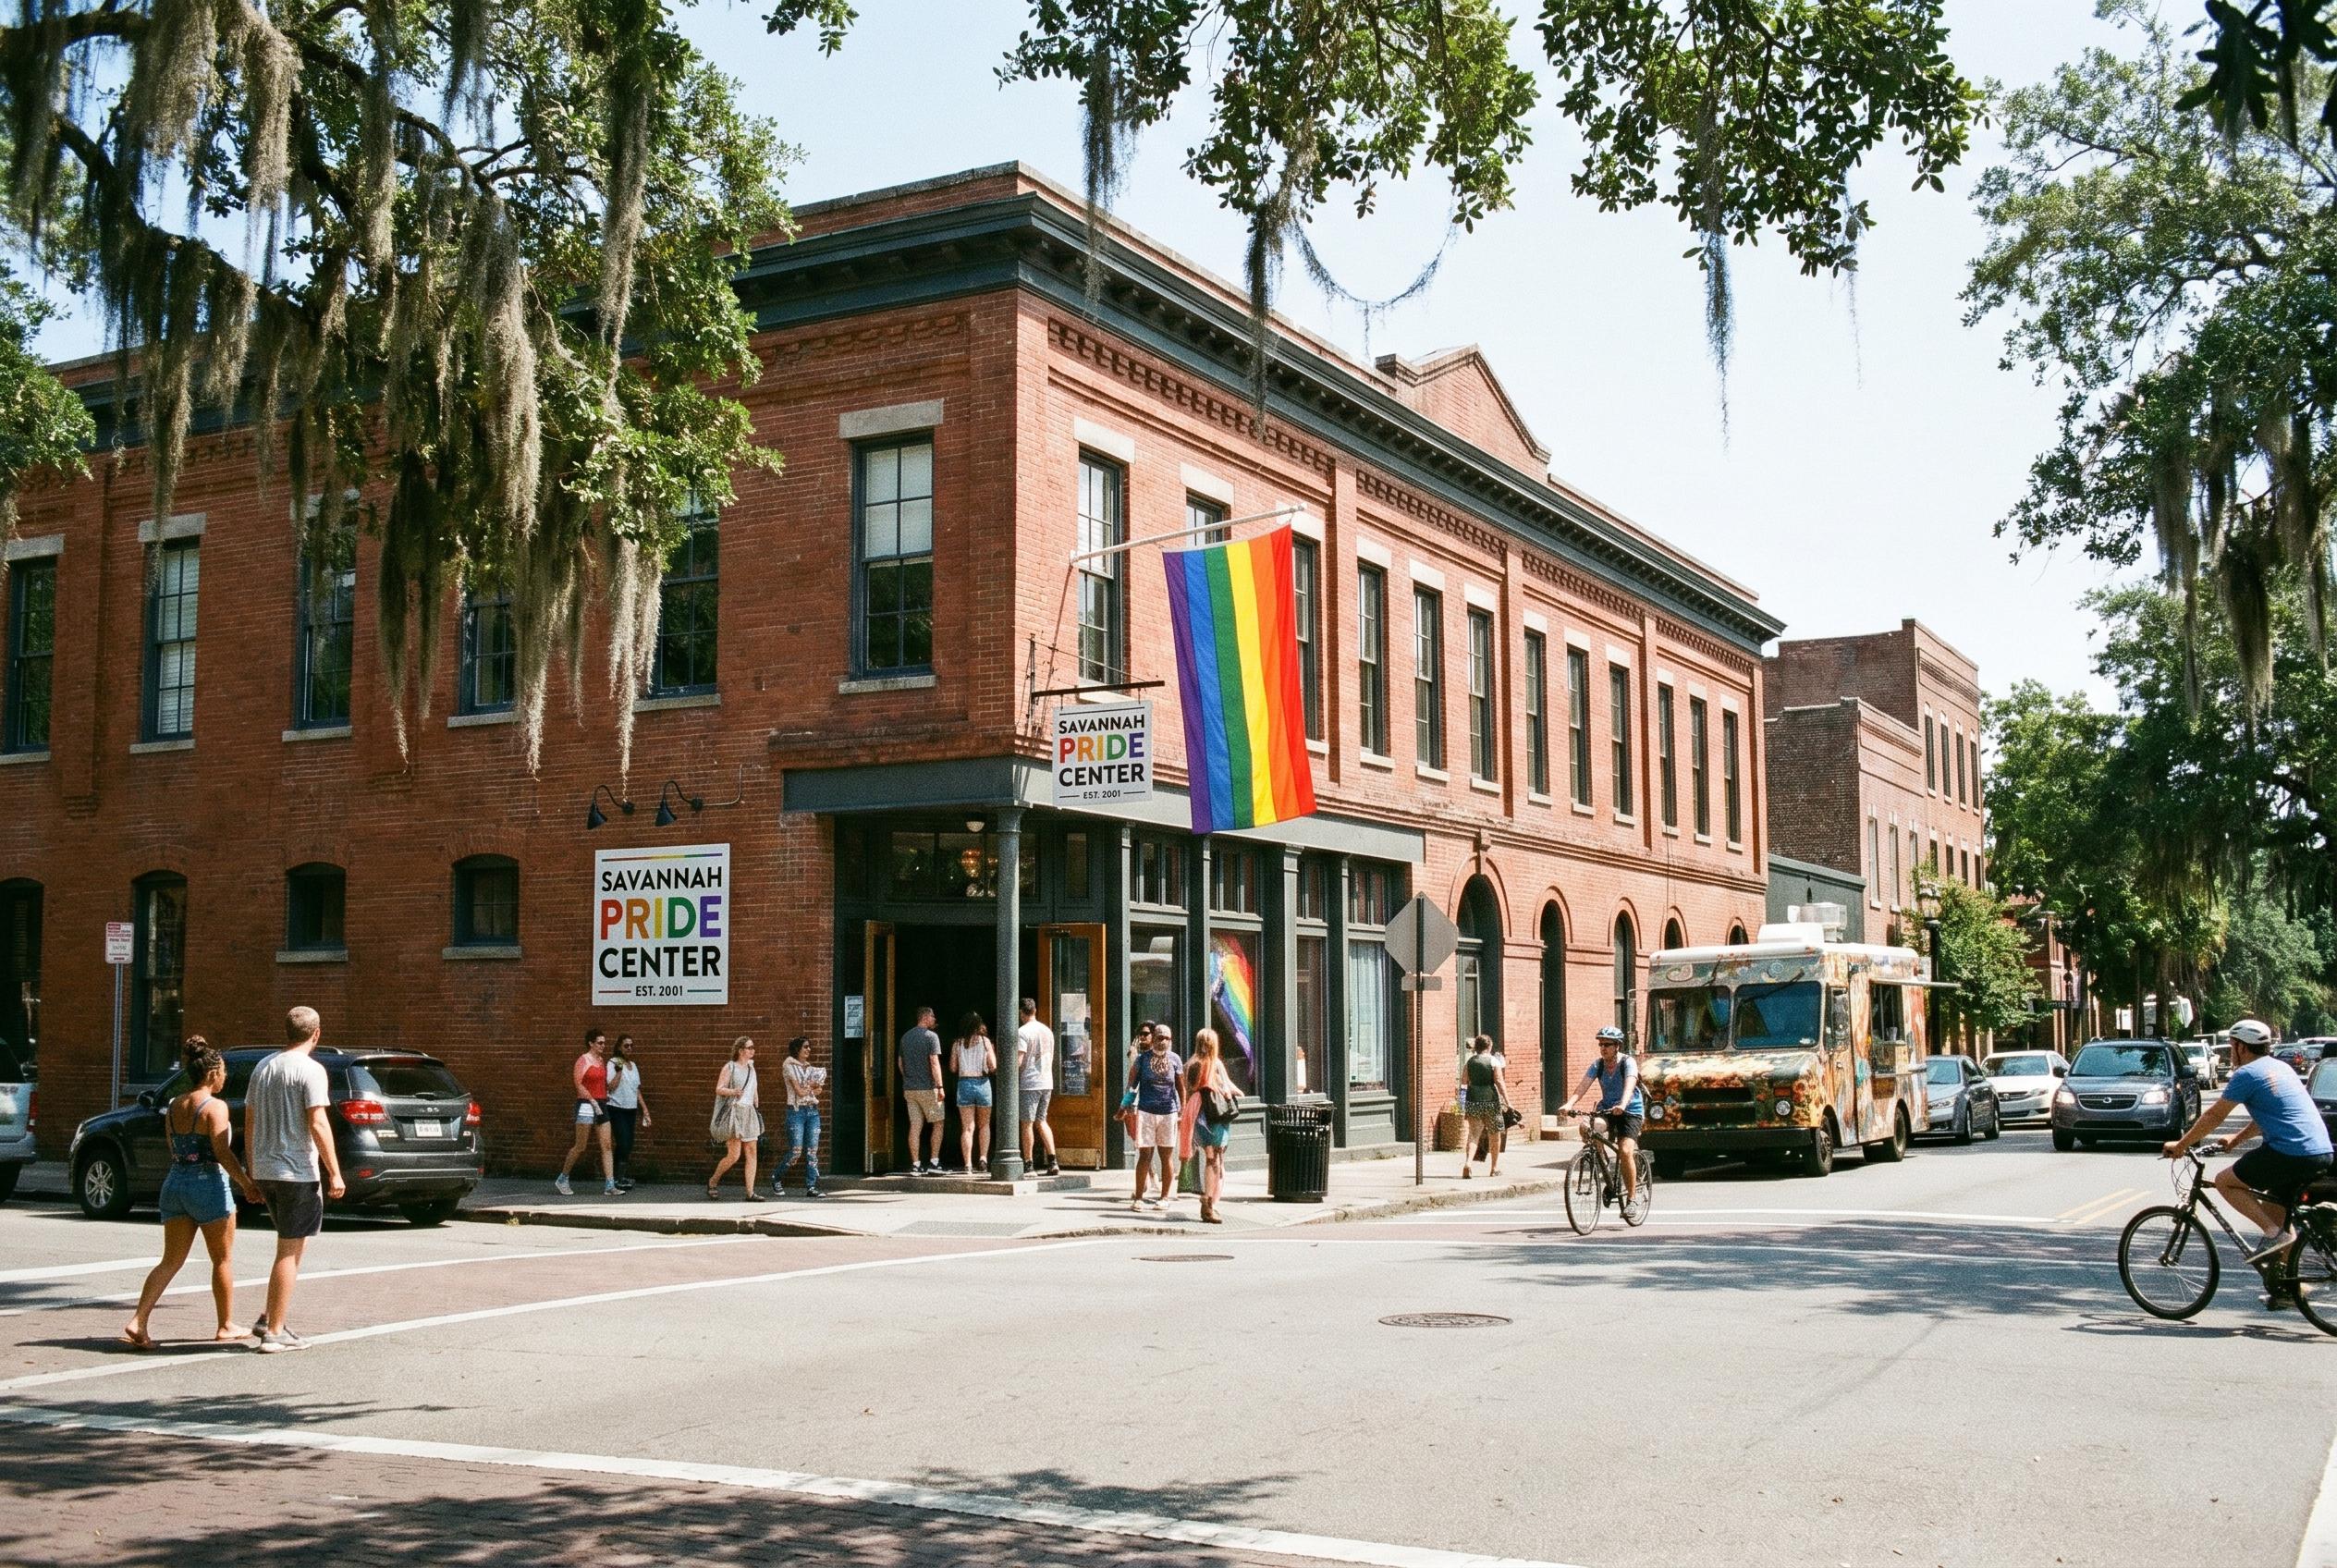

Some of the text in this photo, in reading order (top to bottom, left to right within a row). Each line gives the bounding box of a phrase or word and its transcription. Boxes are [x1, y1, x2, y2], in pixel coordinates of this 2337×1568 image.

[1058, 714, 1144, 734] SAVANNAH
[1059, 731, 1144, 764] PRIDE
[1058, 763, 1144, 787] CENTER
[1083, 790, 1120, 799] EST. 2001
[601, 866, 722, 892] SAVANNAH
[600, 895, 722, 940] PRIDE
[599, 945, 721, 978] CENTER
[635, 986, 683, 997] EST. 2001
